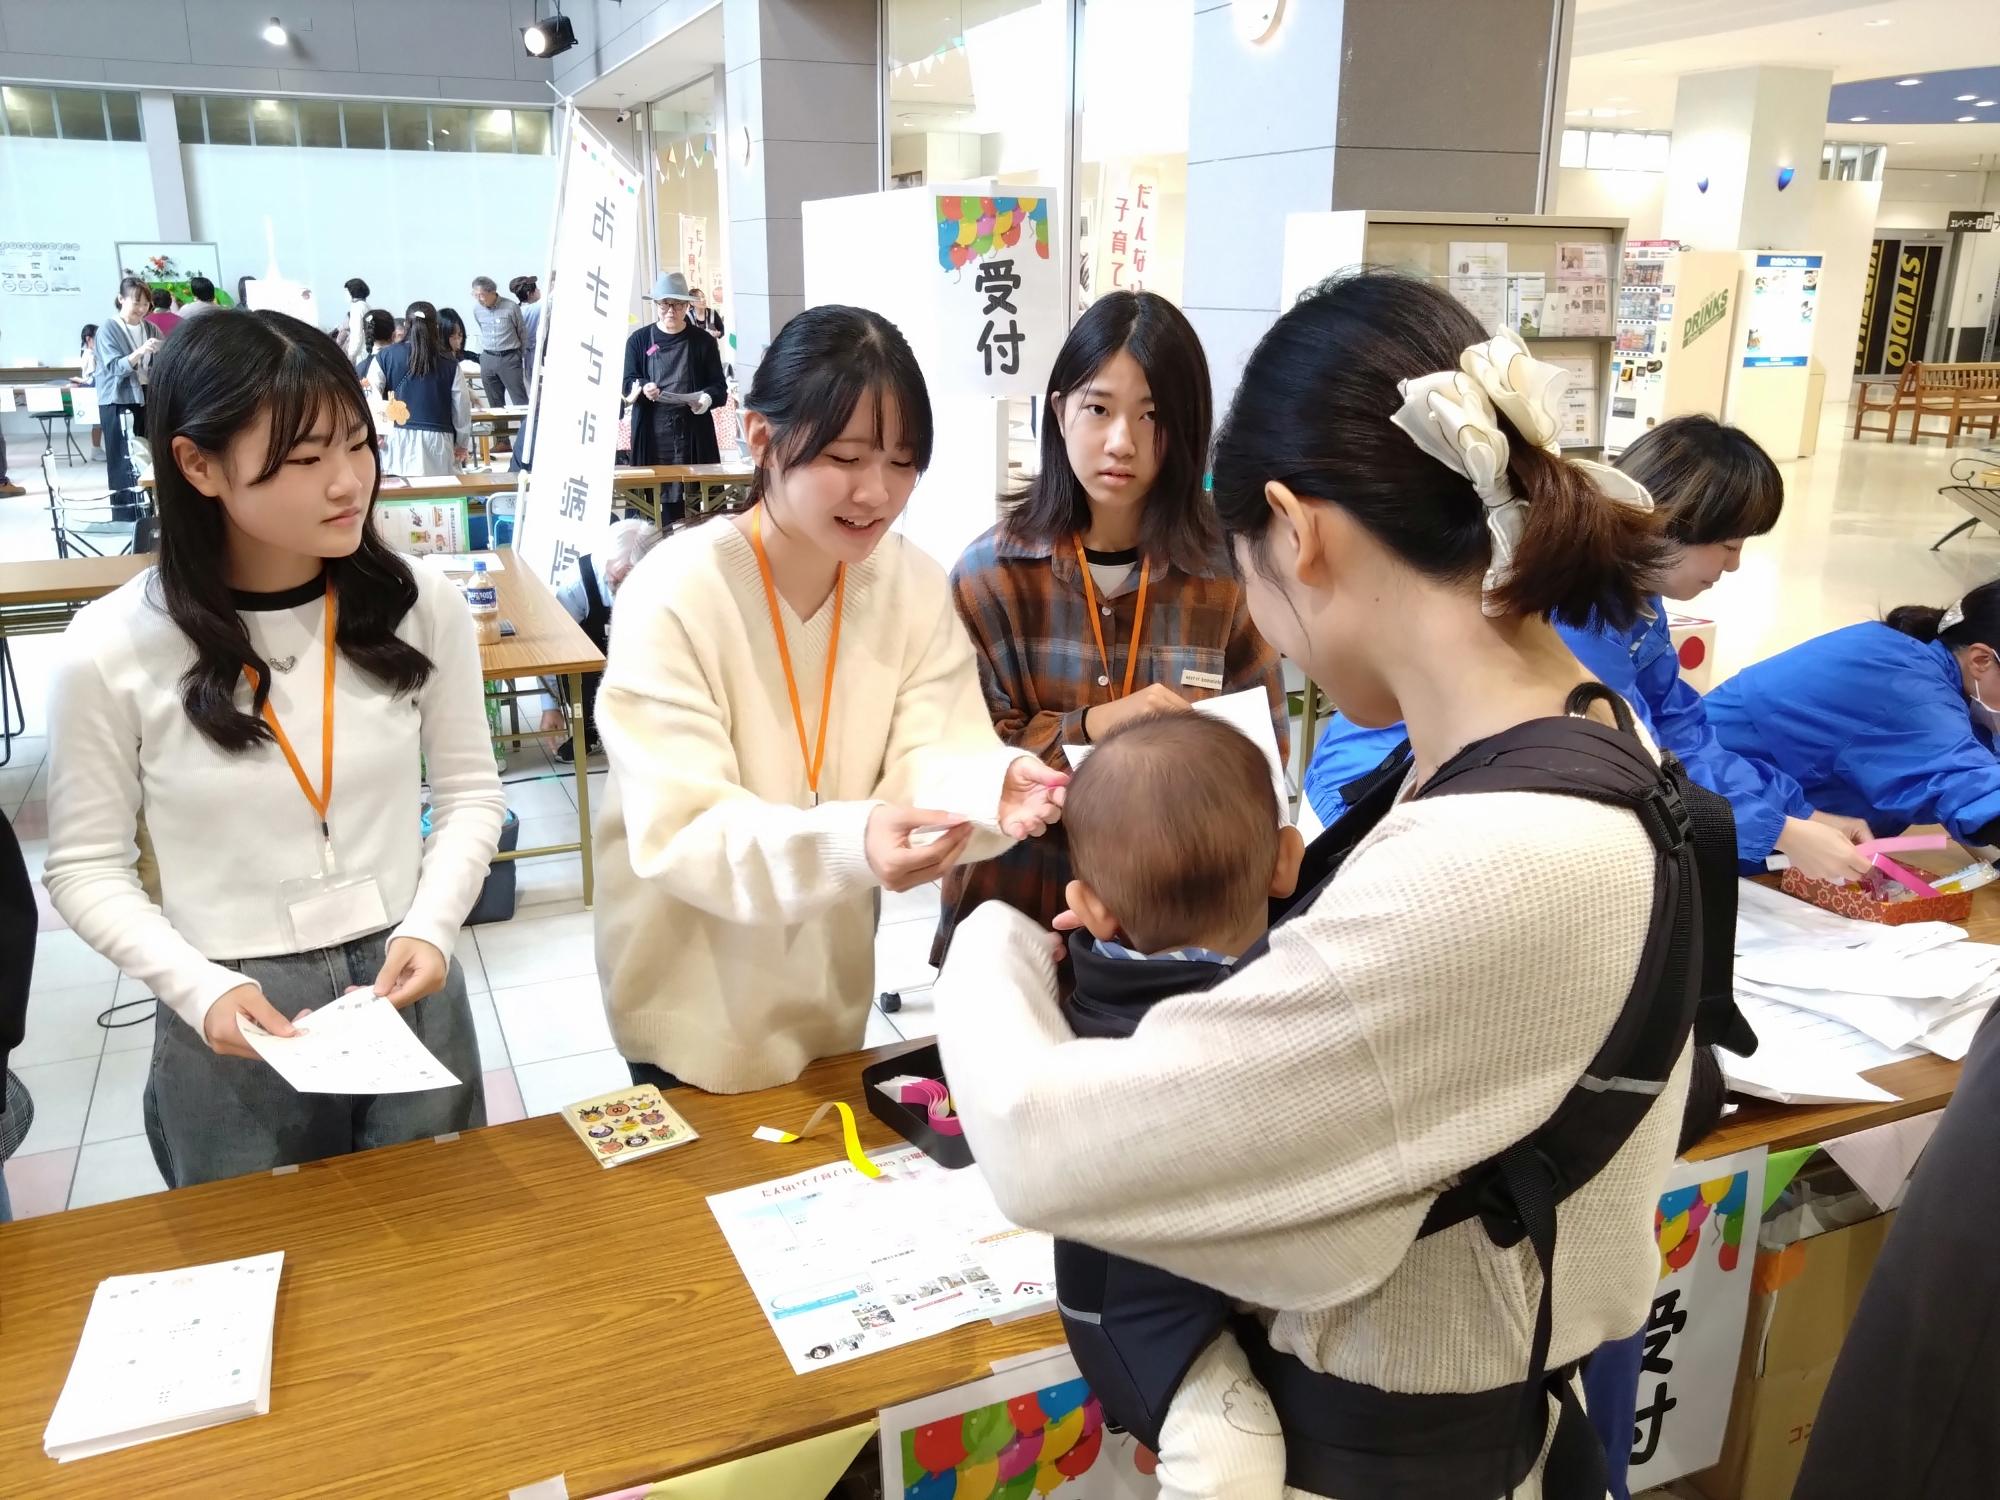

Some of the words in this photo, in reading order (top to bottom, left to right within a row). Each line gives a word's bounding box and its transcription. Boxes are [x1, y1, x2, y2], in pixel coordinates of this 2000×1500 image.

[1111, 197, 1130, 287] 子育て
[975, 259, 1026, 376] 受付
[1683, 288, 1729, 339] DRINKS
[1887, 253, 1921, 367] STUDIO
